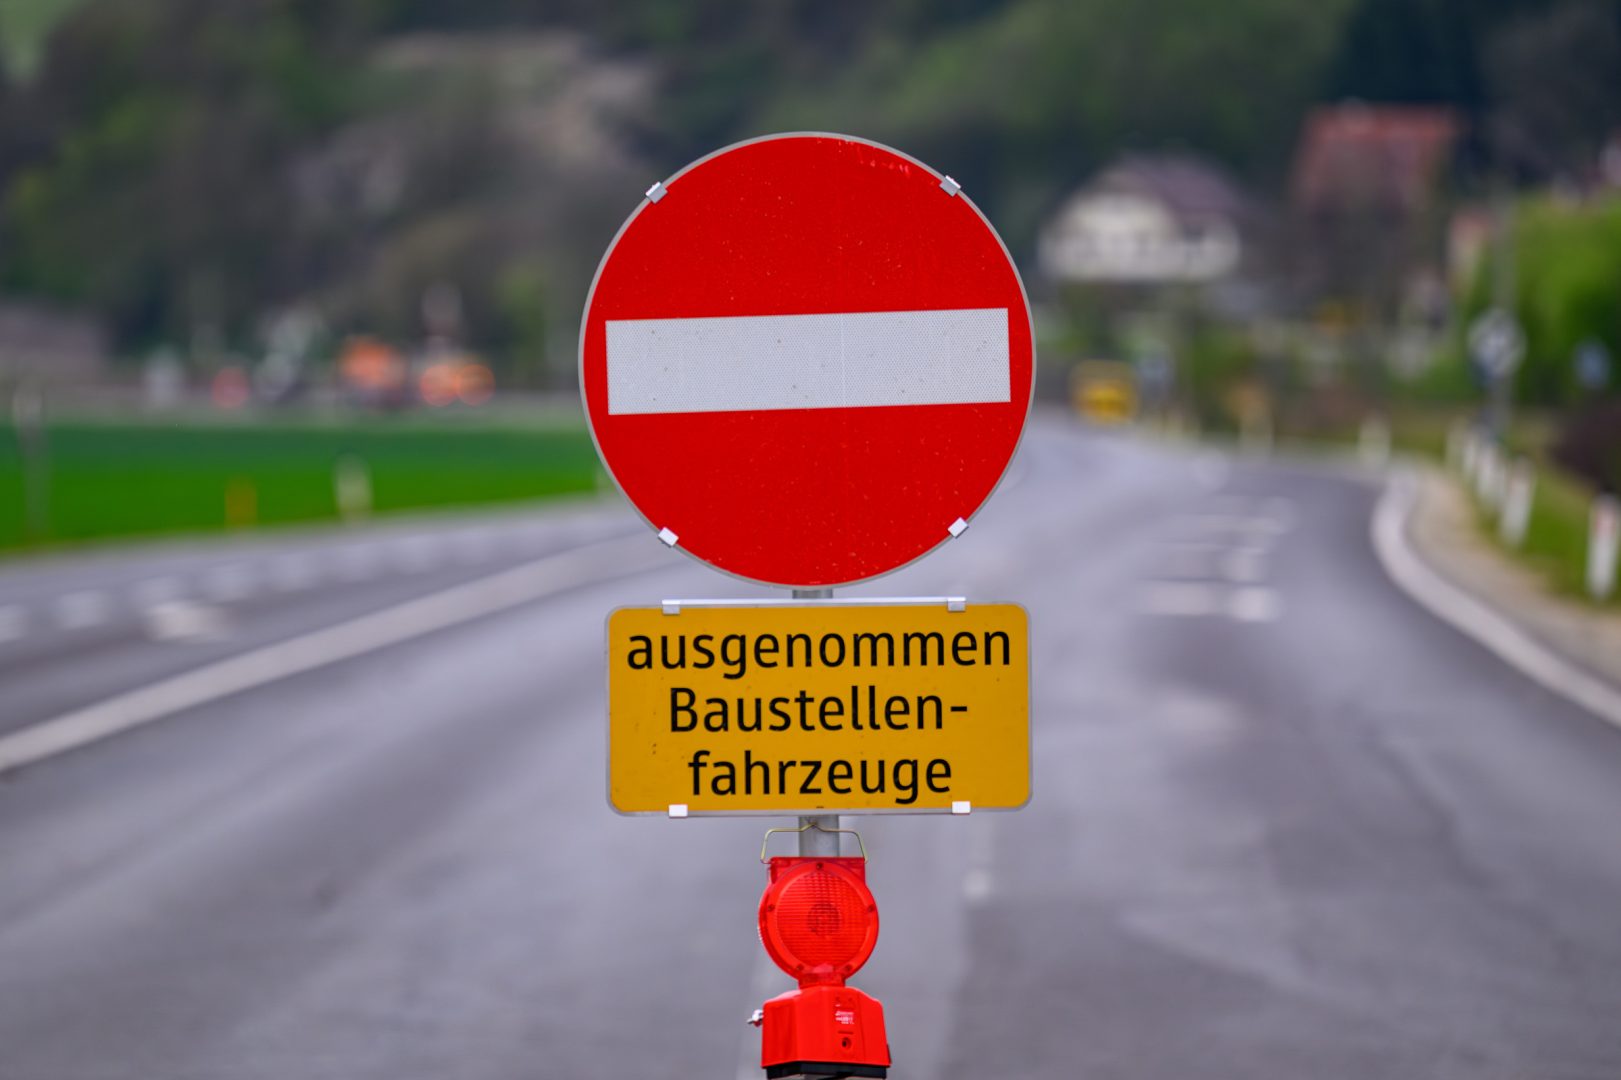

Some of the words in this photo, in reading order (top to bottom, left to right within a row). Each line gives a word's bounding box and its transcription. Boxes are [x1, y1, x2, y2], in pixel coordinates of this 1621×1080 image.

[627, 630, 1011, 680] ausgenommen
[669, 685, 969, 733] Baustellen-
[687, 749, 953, 805] fahrzeuge
